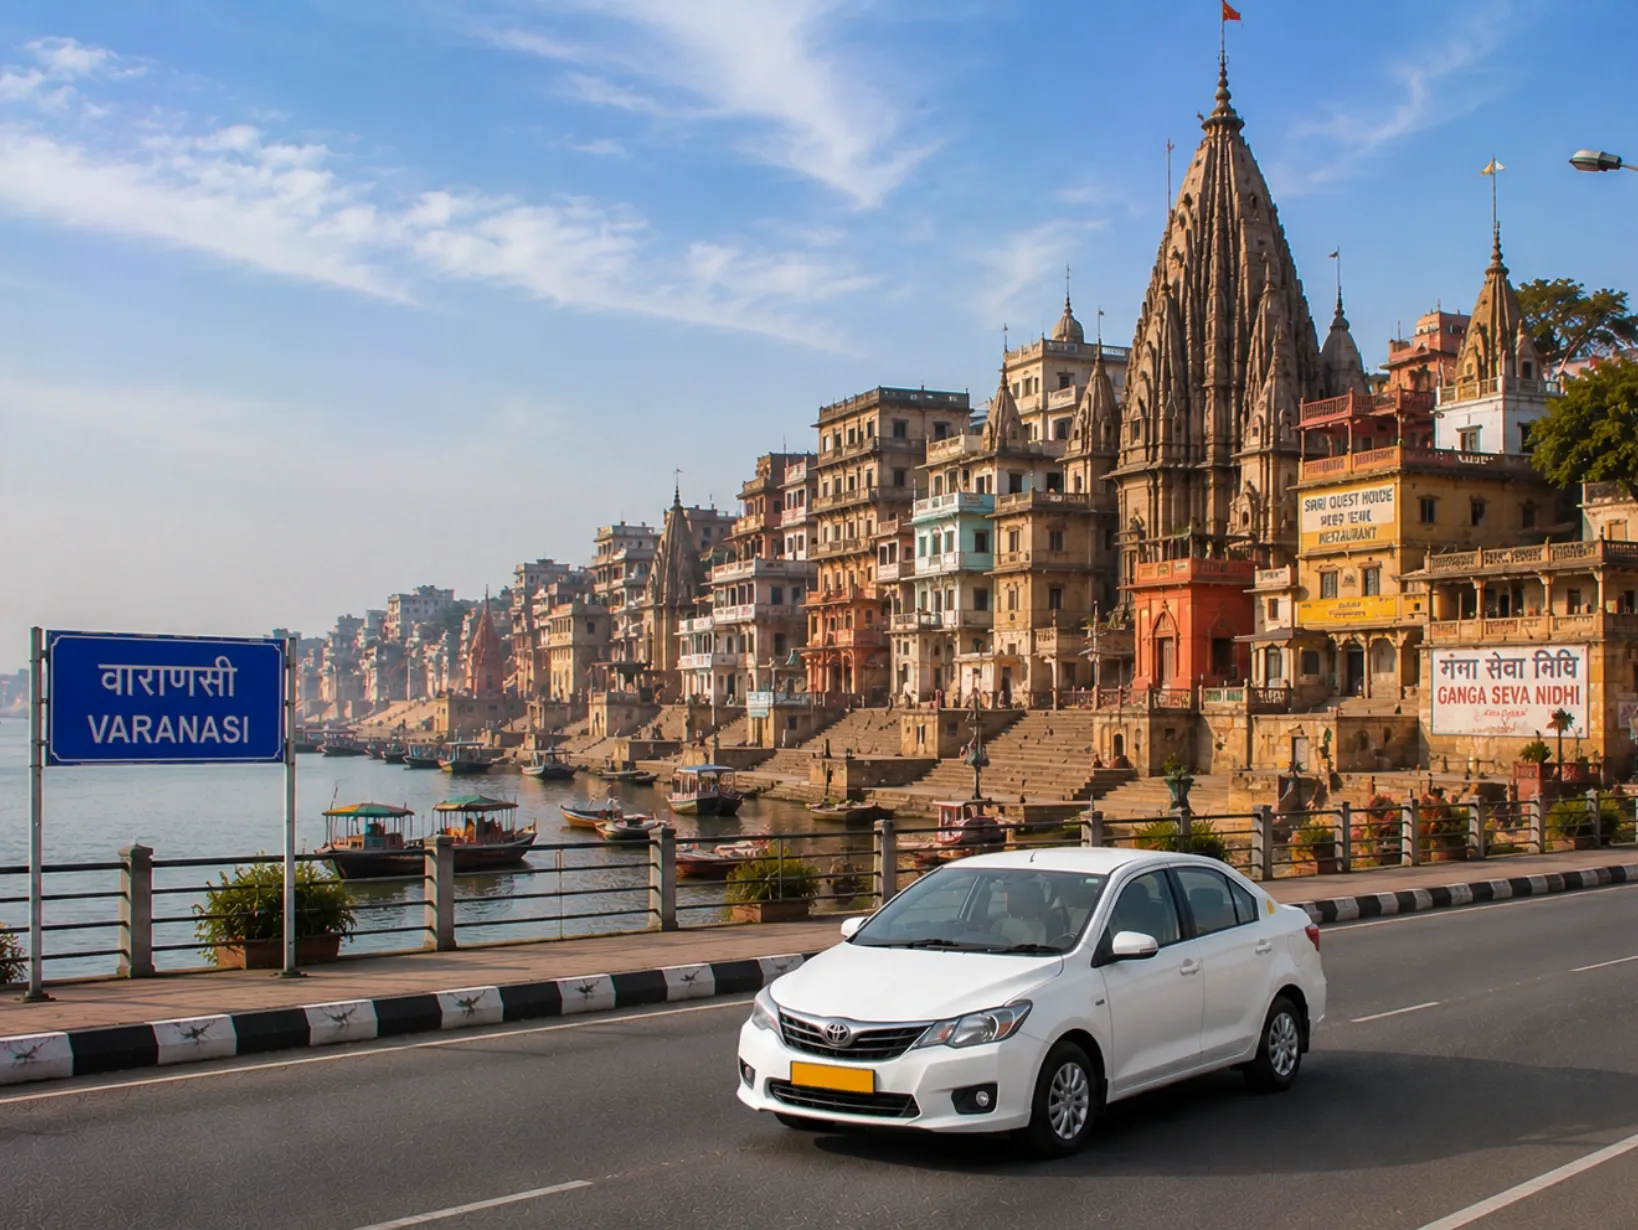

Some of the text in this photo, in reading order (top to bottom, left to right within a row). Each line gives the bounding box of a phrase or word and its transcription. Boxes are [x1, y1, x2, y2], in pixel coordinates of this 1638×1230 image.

[98, 656, 238, 697] वाराणसी
[1484, 651, 1526, 680] सेवा
[1437, 685, 1580, 705] GANGA SEVA NIDHI
[87, 715, 249, 744] VARANASI
